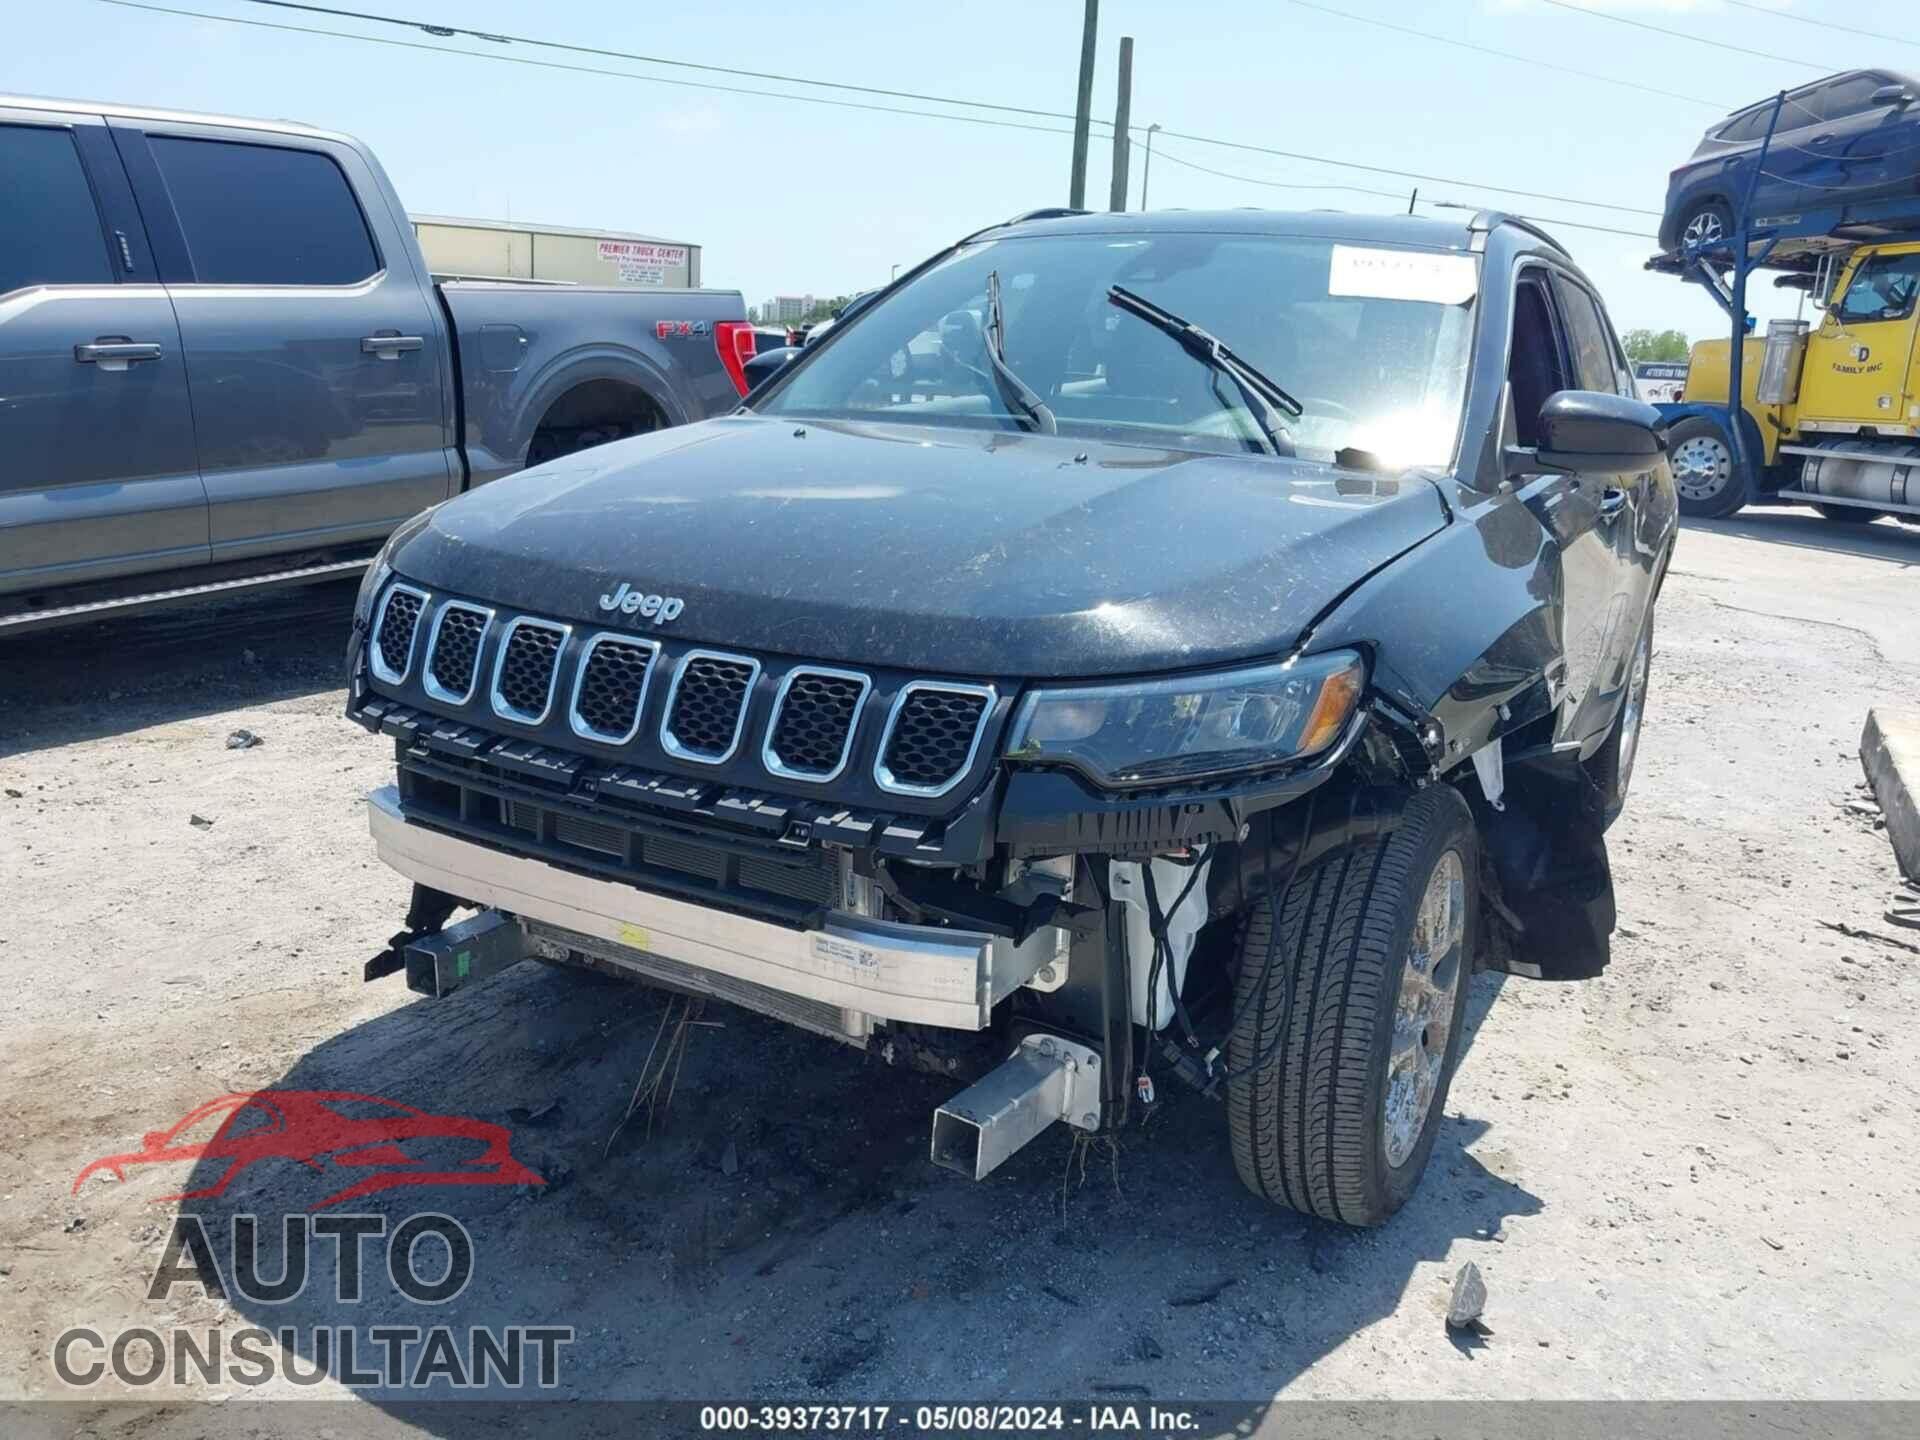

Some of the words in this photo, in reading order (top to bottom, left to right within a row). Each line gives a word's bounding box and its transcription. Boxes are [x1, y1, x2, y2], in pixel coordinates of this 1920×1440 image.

[599, 243, 630, 255] PREMIER
[632, 245, 654, 257] TRUCK
[657, 247, 684, 259] CENTER
[656, 320, 705, 341] FX4
[1832, 362, 1865, 374] FAMILY
[1866, 362, 1883, 373] INC
[600, 583, 684, 625] Jeep
